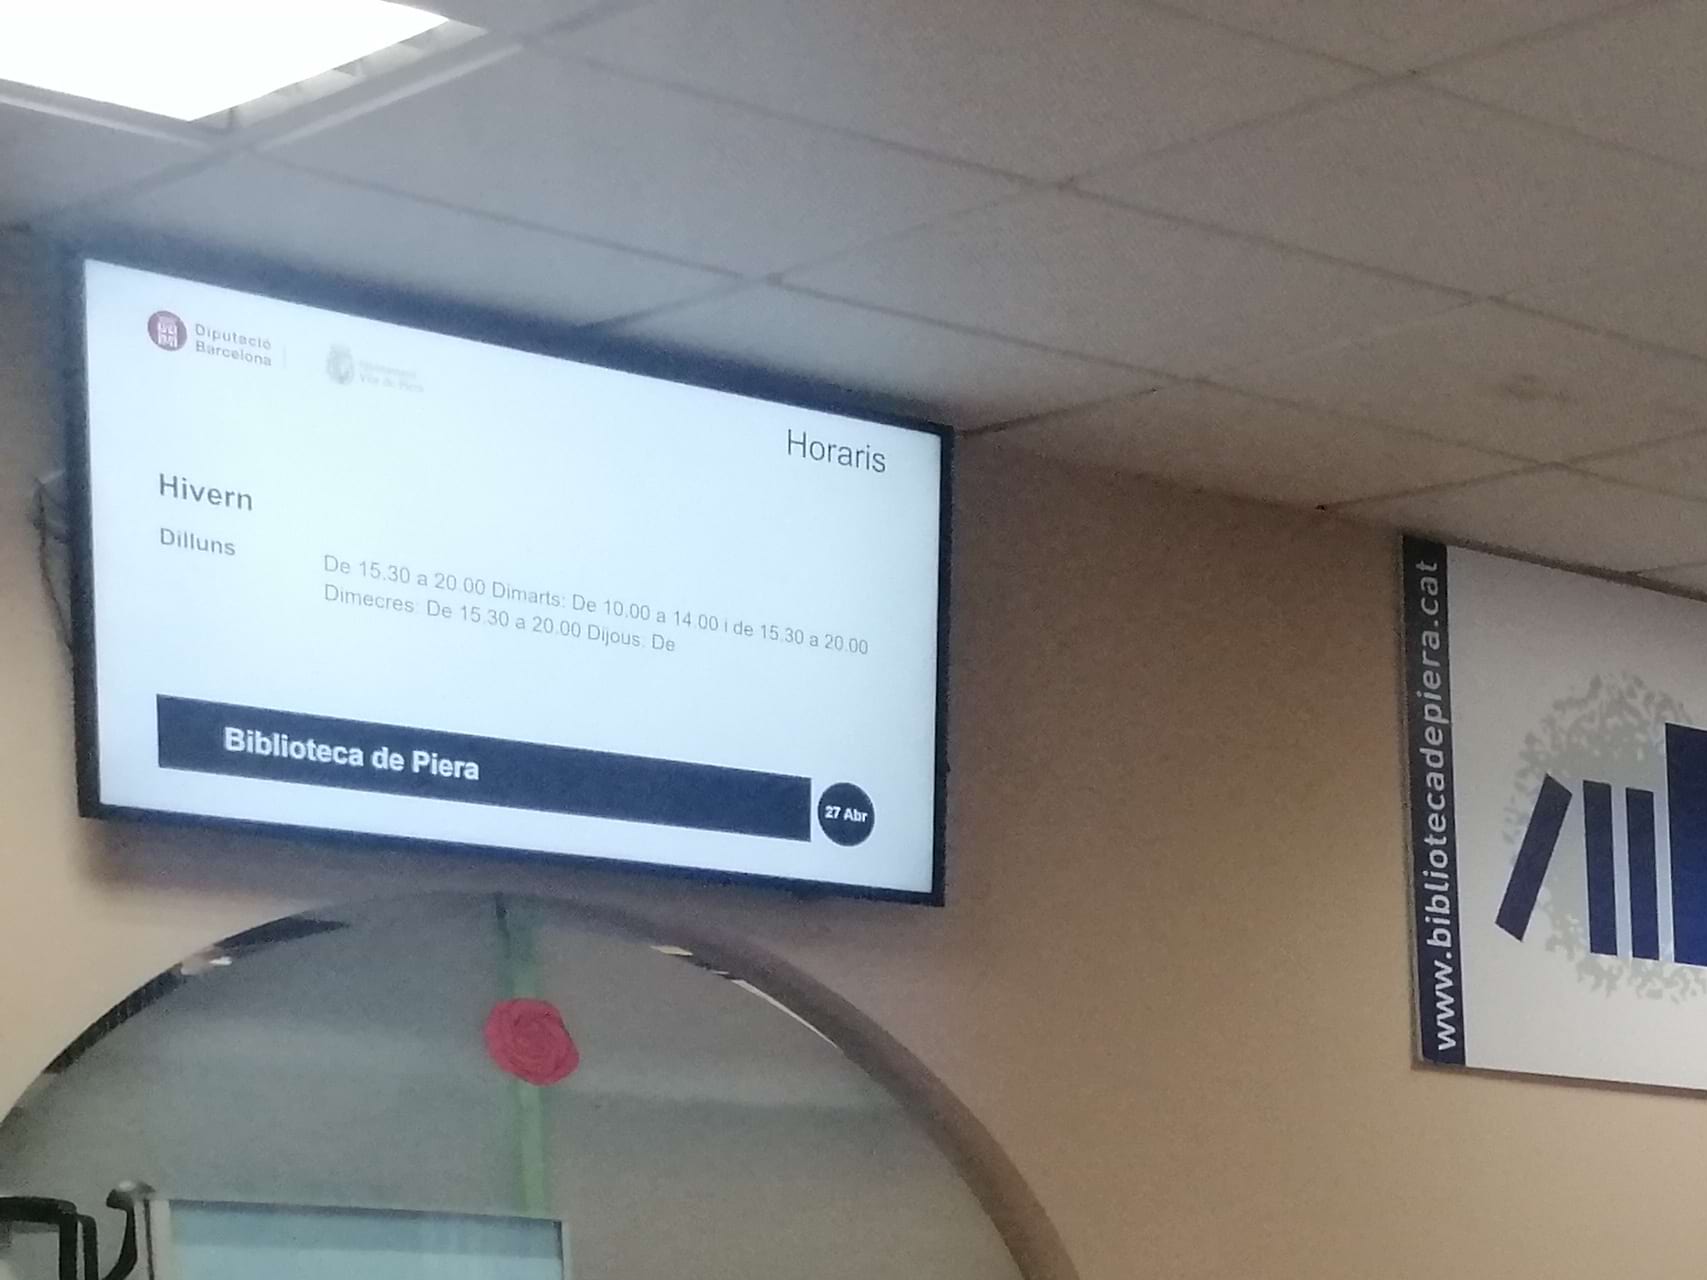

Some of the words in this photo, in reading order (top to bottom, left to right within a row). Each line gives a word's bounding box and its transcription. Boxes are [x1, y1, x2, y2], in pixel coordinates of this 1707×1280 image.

[195, 323, 272, 350] Diputació
[195, 340, 272, 367] Barcelona
[788, 428, 886, 473] Horaris
[159, 473, 252, 511] Hivern
[160, 528, 236, 556] Dilluns
[324, 555, 350, 574] De
[359, 561, 410, 584] 15.30
[417, 573, 428, 587] a
[492, 581, 566, 607] Dimarts:
[572, 593, 597, 612] De
[604, 600, 650, 620] 10.00
[656, 609, 666, 623] a
[673, 610, 719, 631] 14.00
[733, 621, 753, 637] de
[760, 624, 804, 645] 15.30
[809, 633, 819, 647] a
[824, 634, 868, 655] 20.00
[427, 600, 452, 618] De
[460, 605, 509, 627] 15.30
[516, 618, 525, 629] a
[532, 616, 581, 639] 20.00
[652, 634, 675, 652] De
[223, 726, 364, 767] Biblioteca
[371, 747, 404, 771] de
[412, 750, 480, 781] Piera
[825, 805, 841, 819] 27
[844, 808, 868, 822] Abr
[1416, 559, 1456, 1052] www.bibliotecadepiera.cat
